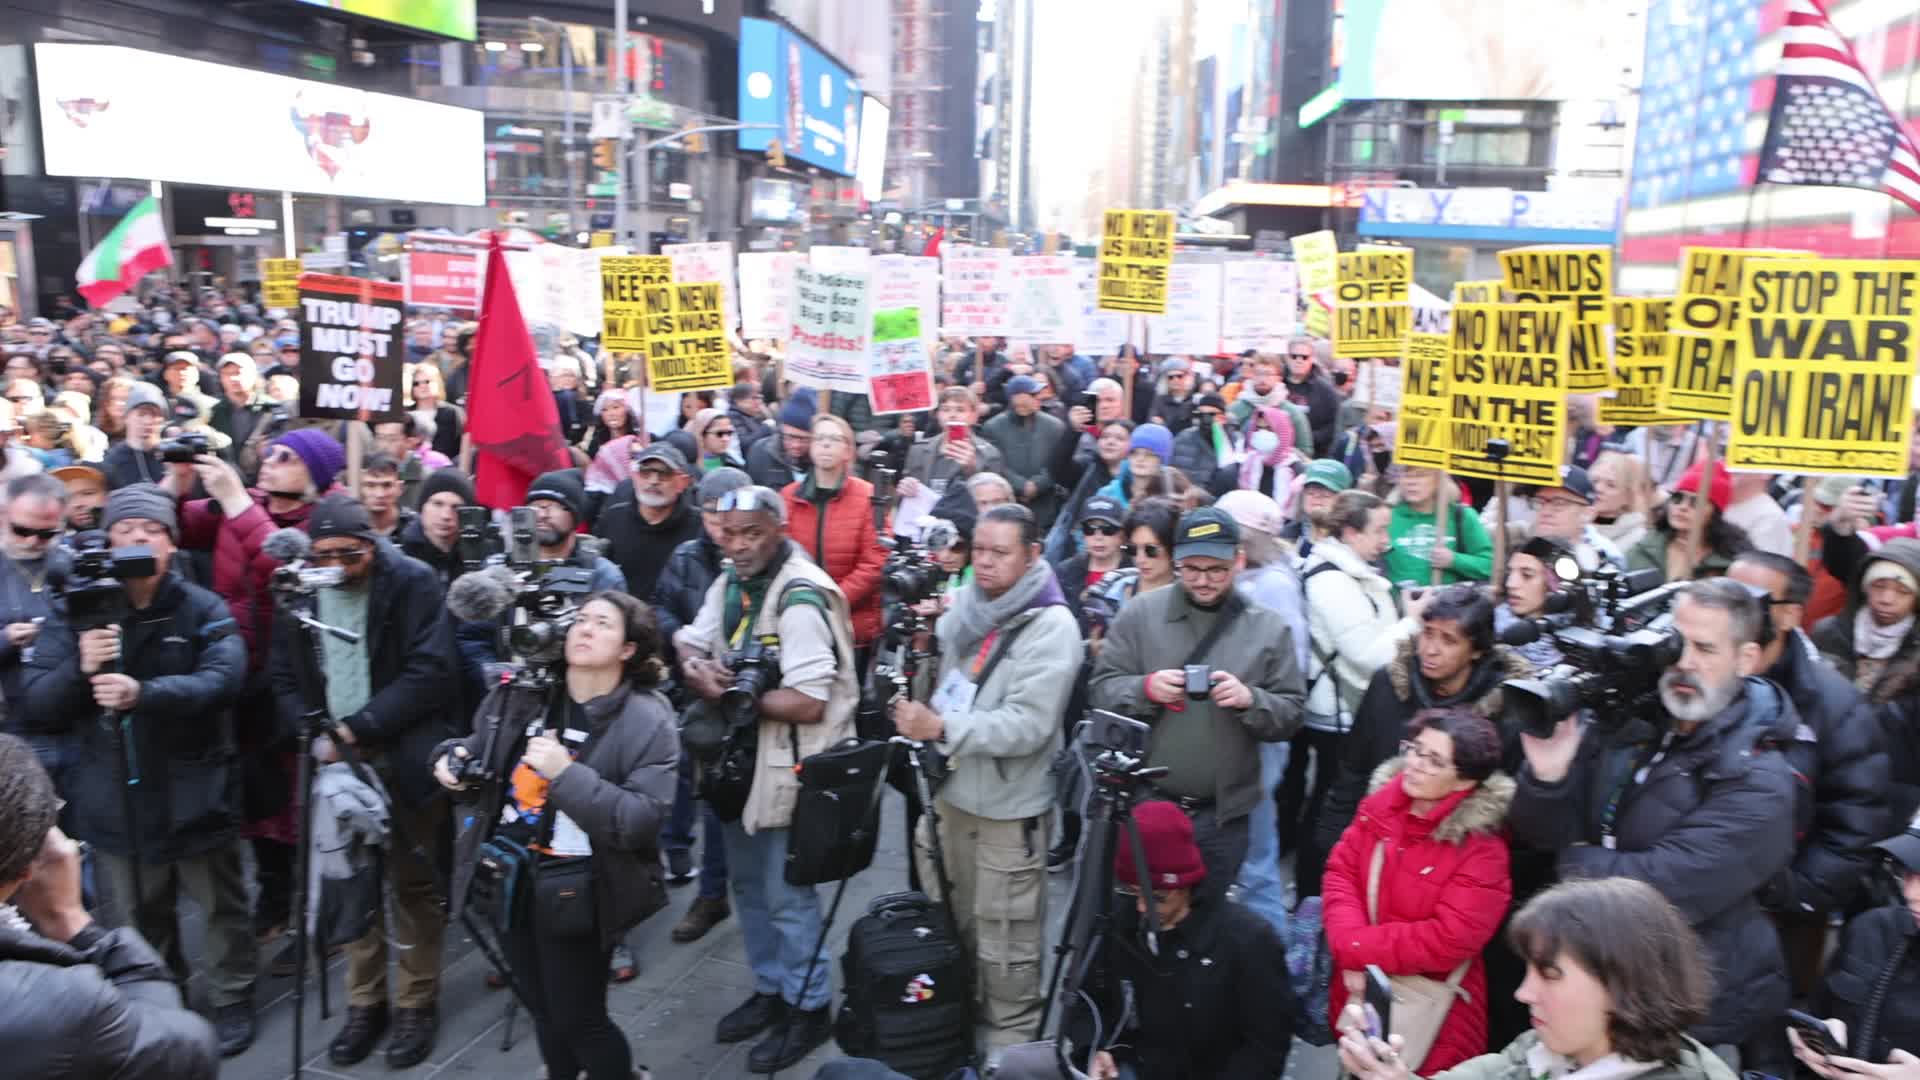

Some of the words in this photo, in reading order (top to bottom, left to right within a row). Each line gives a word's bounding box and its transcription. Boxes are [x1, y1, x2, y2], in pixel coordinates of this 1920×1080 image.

[1132, 214, 1168, 239] NEW
[1104, 239, 1123, 257] US
[1128, 241, 1167, 258] WAR
[1127, 263, 1166, 280] THE
[1339, 254, 1406, 280] HANDS
[1507, 253, 1603, 291] HANDS
[646, 287, 671, 313] NO
[677, 285, 720, 311] NEW
[1340, 282, 1407, 302] OFF
[1751, 270, 1840, 315] STOP
[1854, 271, 1916, 316] THE
[301, 298, 401, 331] TRUMP
[648, 315, 673, 335] US
[677, 313, 720, 333] WAR
[311, 327, 393, 357] MUST
[791, 323, 865, 351] Profits!
[1455, 309, 1486, 351] NO
[1497, 310, 1562, 354] NEW
[1750, 318, 1910, 363] WAR
[651, 341, 674, 358] IN
[680, 337, 723, 355] THE
[331, 356, 375, 382] GO
[653, 357, 697, 378] MIDDLE
[1455, 354, 1485, 384] US
[1492, 356, 1559, 388] WAR
[1673, 336, 1737, 393] IRA
[316, 383, 393, 412] NOW!
[1405, 405, 1443, 416] NOT
[1453, 394, 1481, 420] IN
[1487, 397, 1555, 426] THE
[1742, 369, 1792, 437] ON
[1803, 371, 1907, 442] IRAN!
[1511, 427, 1553, 460] EAST
